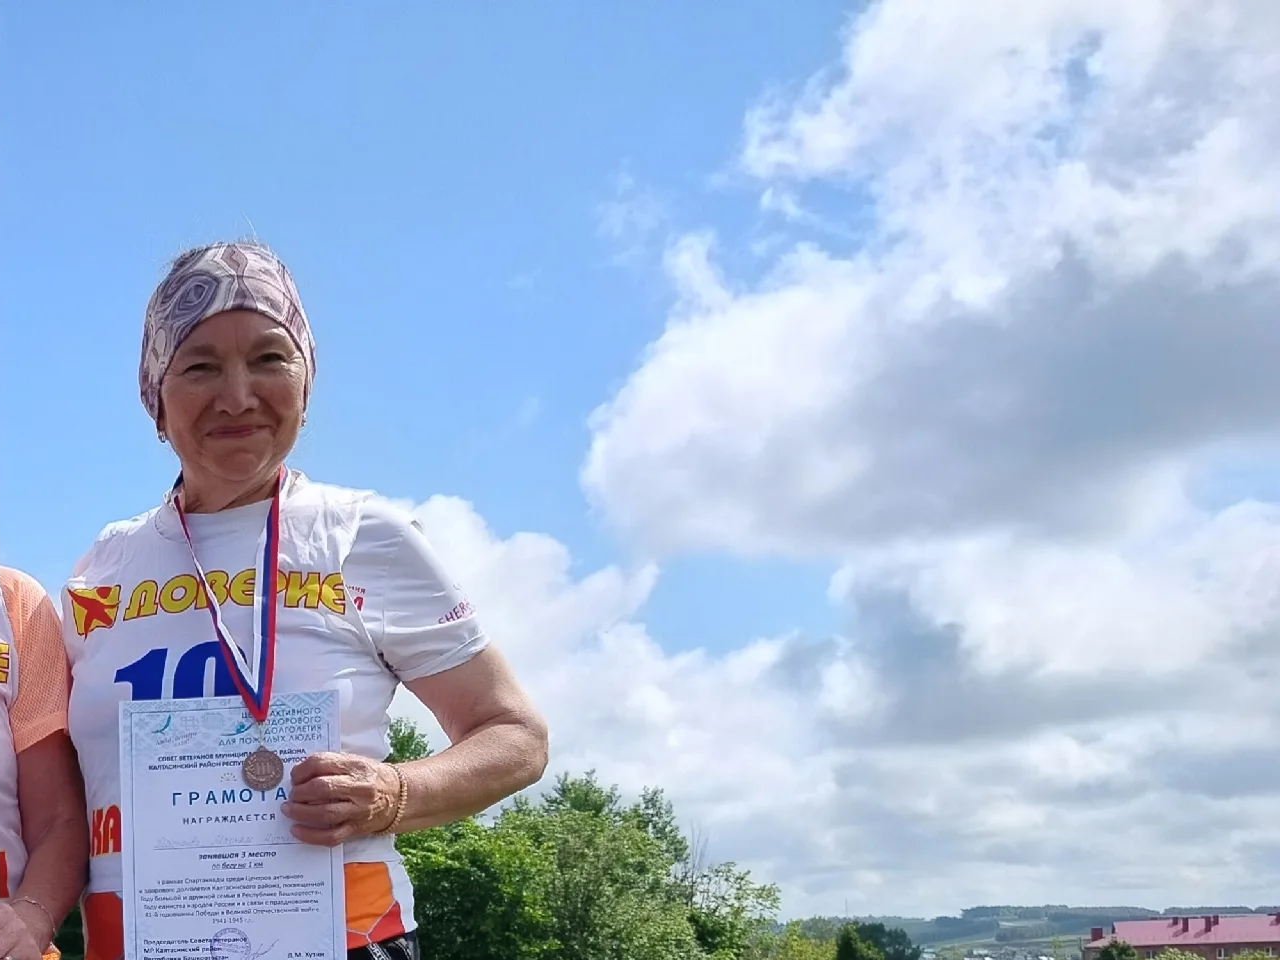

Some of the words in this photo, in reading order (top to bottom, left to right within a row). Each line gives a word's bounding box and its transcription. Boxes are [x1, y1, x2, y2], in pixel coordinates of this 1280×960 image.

[270, 707, 320, 717] АКТИВНОГО
[264, 724, 321, 734] ДОЛГОЛЕТИЯ
[218, 737, 237, 745] ДЛЯ
[288, 733, 321, 742] ЛЮДЕЙ
[182, 813, 275, 824] НАГРАЖДАЕТСЯ
[91, 804, 122, 857] КА
